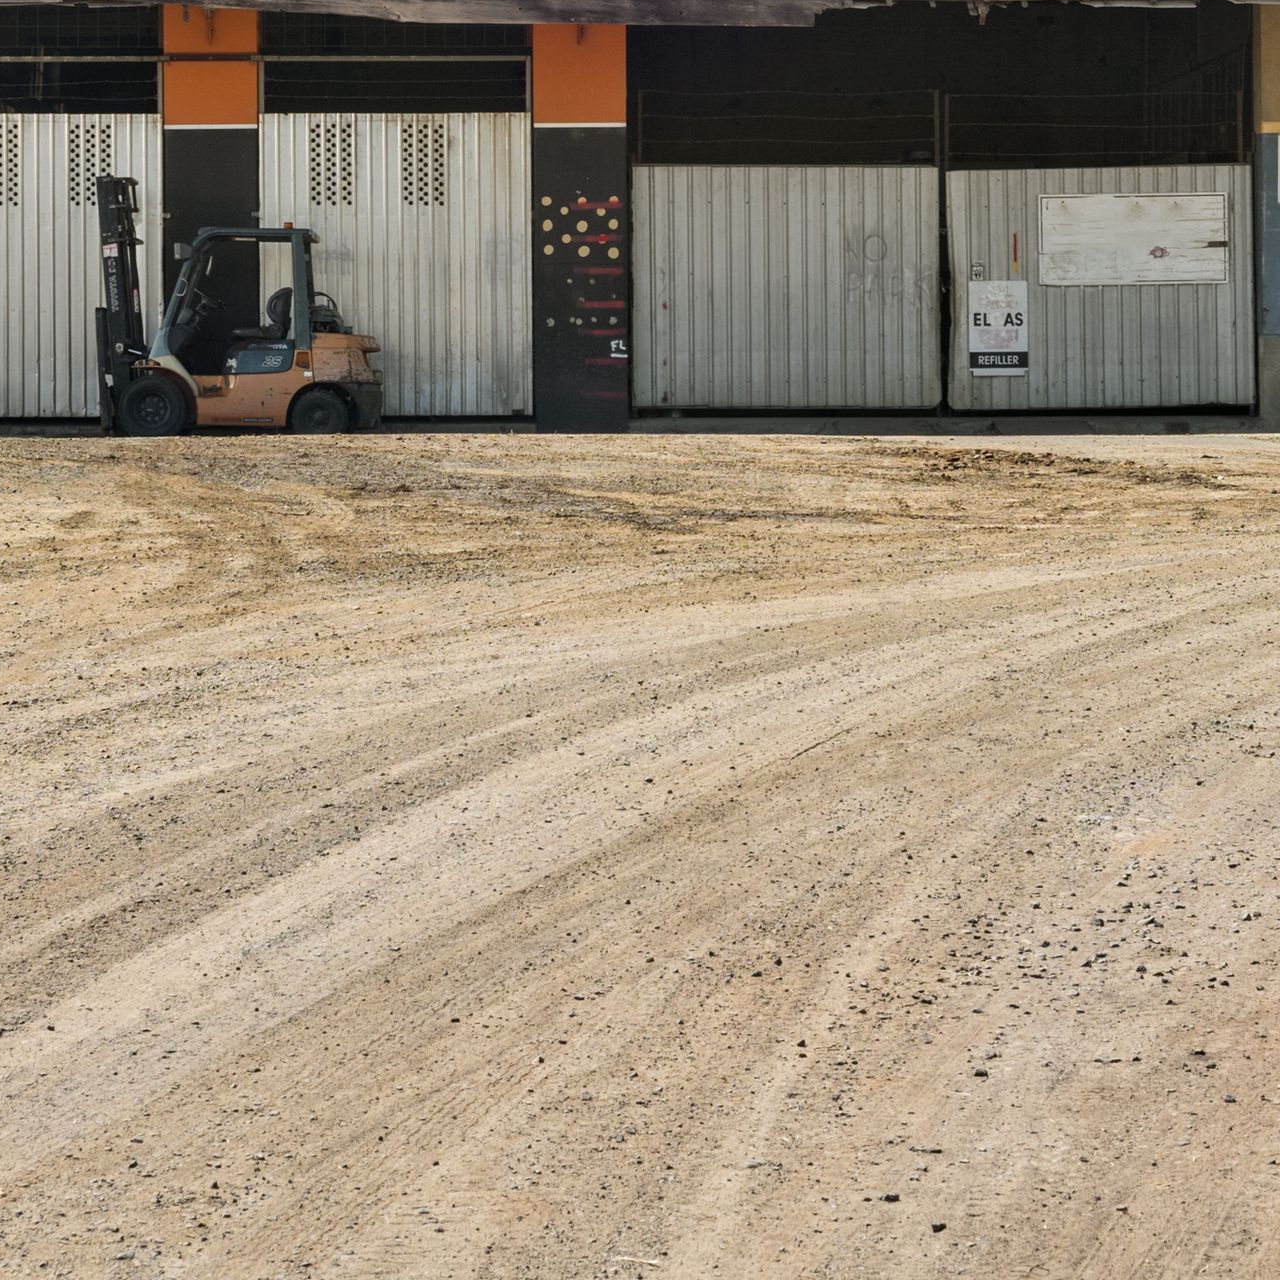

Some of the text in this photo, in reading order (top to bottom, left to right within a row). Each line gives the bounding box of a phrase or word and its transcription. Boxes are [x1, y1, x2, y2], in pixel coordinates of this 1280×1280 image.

[973, 312, 1024, 327] ELAS
[610, 339, 627, 351] FL
[261, 355, 283, 368] 25
[978, 355, 1020, 366] REFILLER
